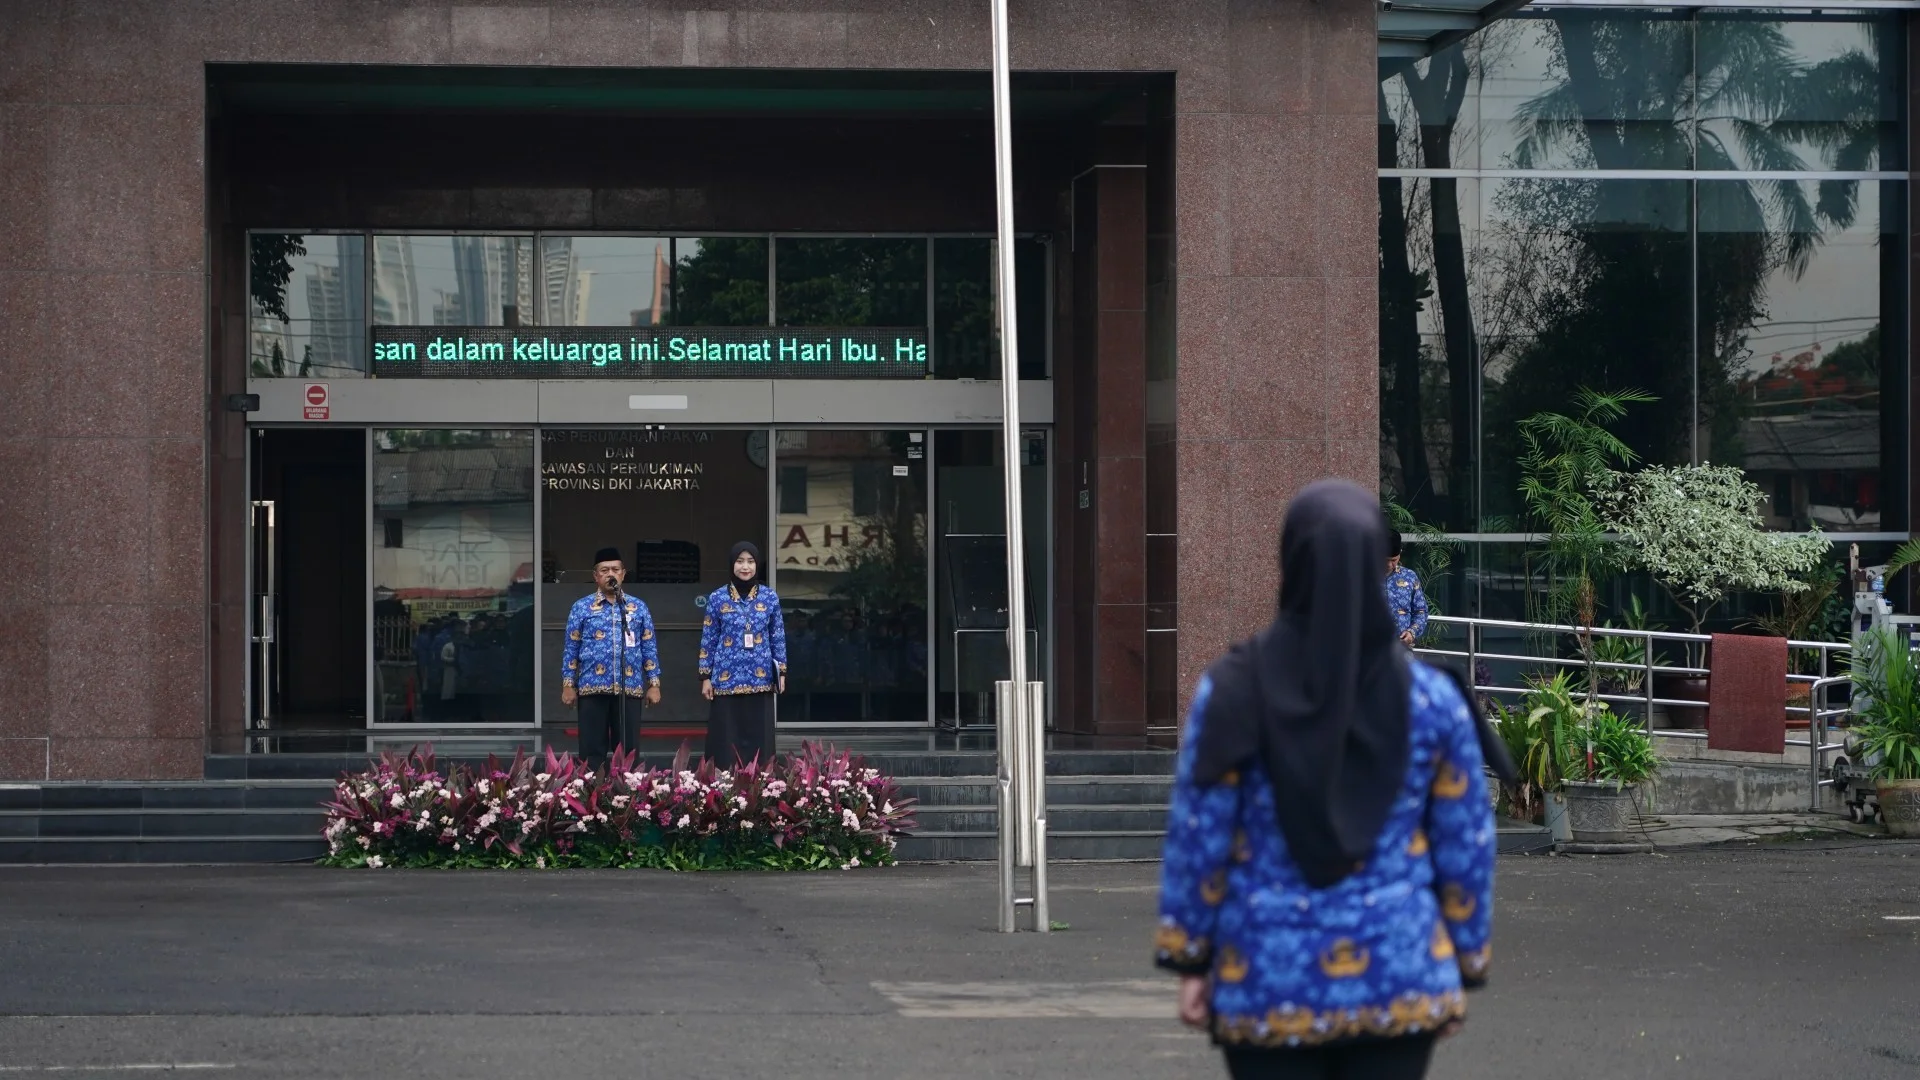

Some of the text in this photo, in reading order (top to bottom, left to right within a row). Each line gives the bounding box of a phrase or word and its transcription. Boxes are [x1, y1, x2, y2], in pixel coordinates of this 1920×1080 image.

[374, 342, 416, 361] san
[426, 337, 504, 361] dalam
[512, 337, 622, 367] keluarga
[779, 338, 831, 361] Hari
[841, 338, 885, 361] Ibu.
[895, 338, 926, 361] Ha
[569, 431, 659, 443] PERUMAHAN
[661, 431, 715, 443] RAKYAT
[605, 447, 635, 459] DAN
[609, 462, 704, 475] PERMUKIMAN
[541, 478, 701, 490] PROVINSI DKI JAKARTA
